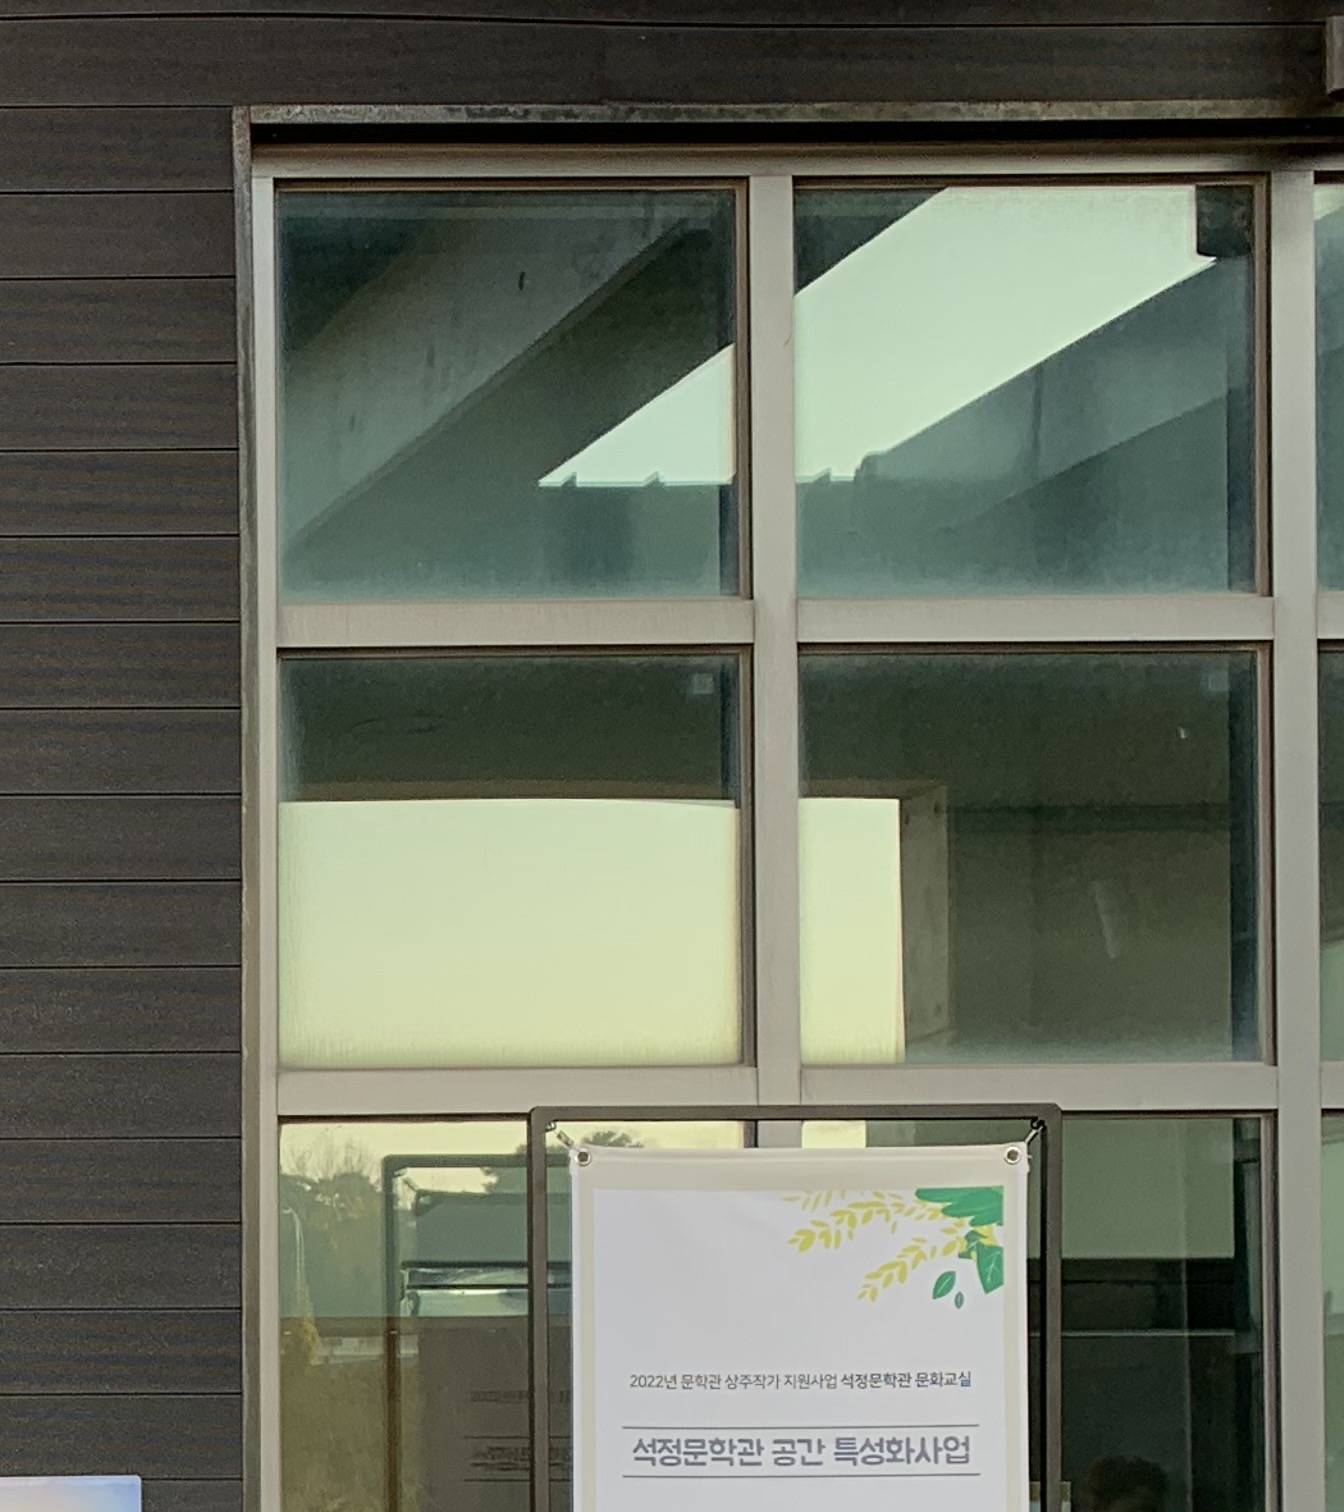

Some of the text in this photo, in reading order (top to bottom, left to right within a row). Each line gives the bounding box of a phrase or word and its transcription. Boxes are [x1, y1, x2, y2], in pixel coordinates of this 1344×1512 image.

[630, 1371, 972, 1390] 2022년 문학관 상주작가 지원사업 석정문학관 문화교실
[633, 1435, 970, 1467] 석정문학관 공간 특성화사업
